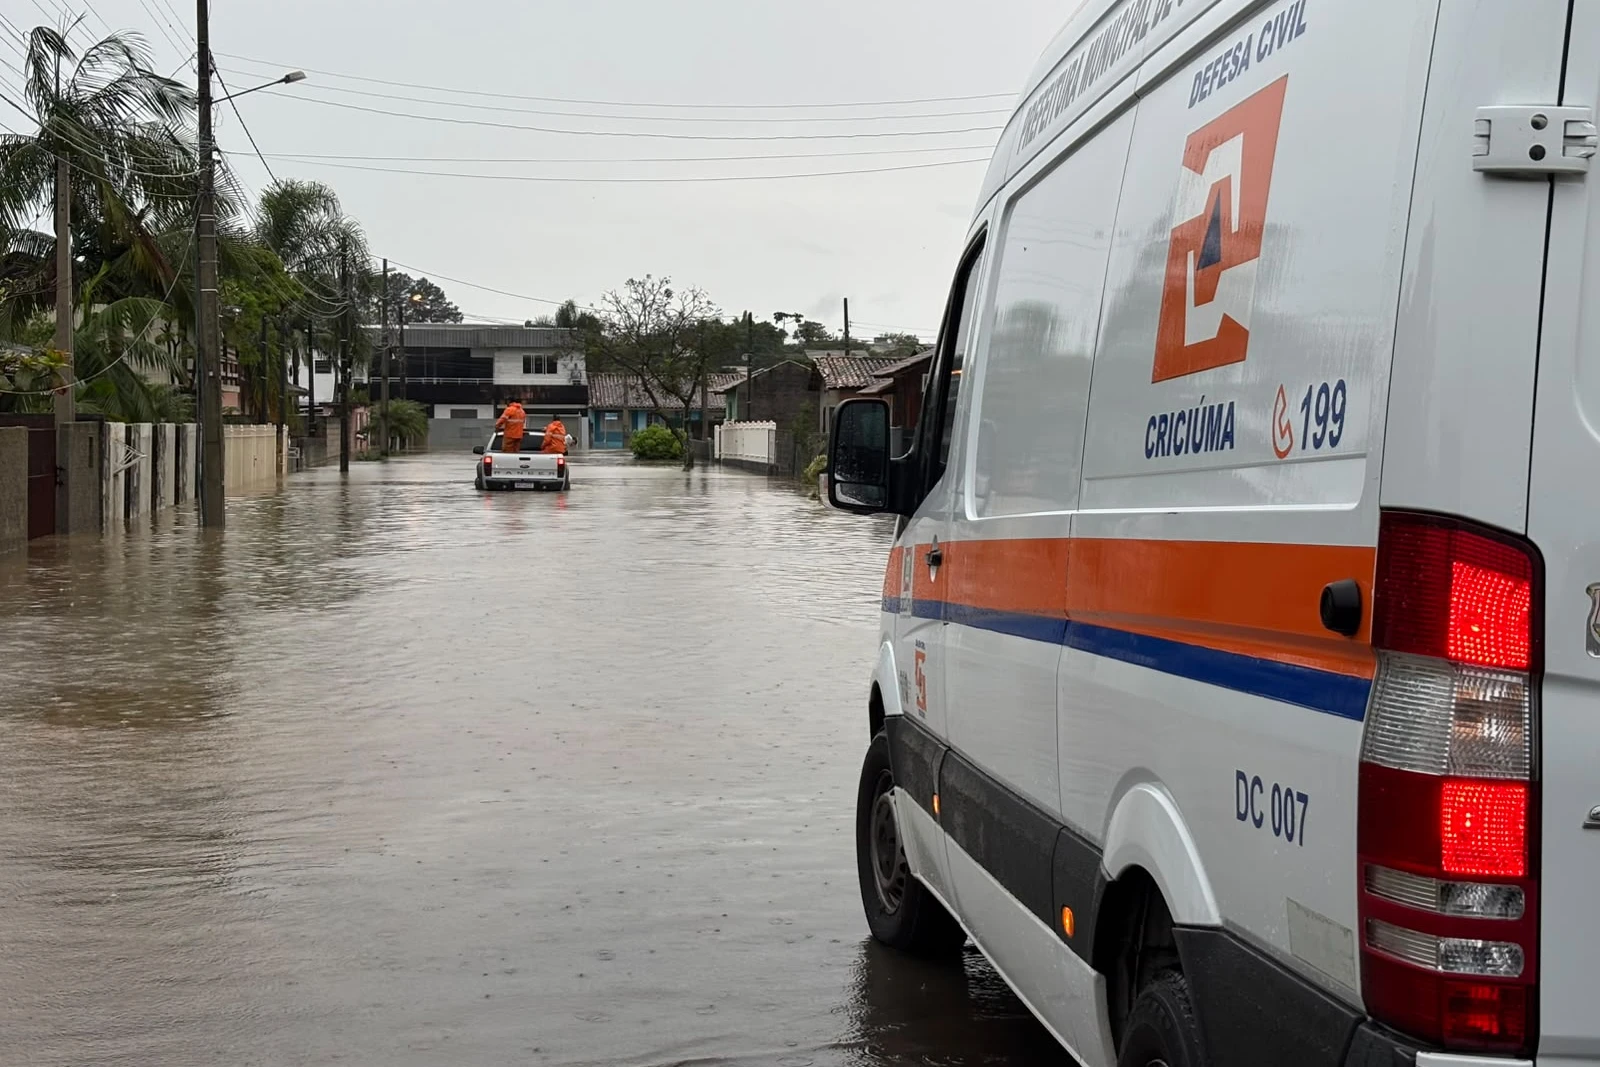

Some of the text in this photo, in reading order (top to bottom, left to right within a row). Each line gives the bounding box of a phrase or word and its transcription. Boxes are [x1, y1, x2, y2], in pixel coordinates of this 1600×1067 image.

[1016, 50, 1086, 156] PREFEITURA
[1077, 0, 1152, 98] MUNICIPAL
[1187, 0, 1307, 109] DEFESA CIVIL
[1144, 395, 1235, 459] CRICIÚMA
[1300, 379, 1347, 450] 199
[1235, 769, 1309, 847] DC 007
